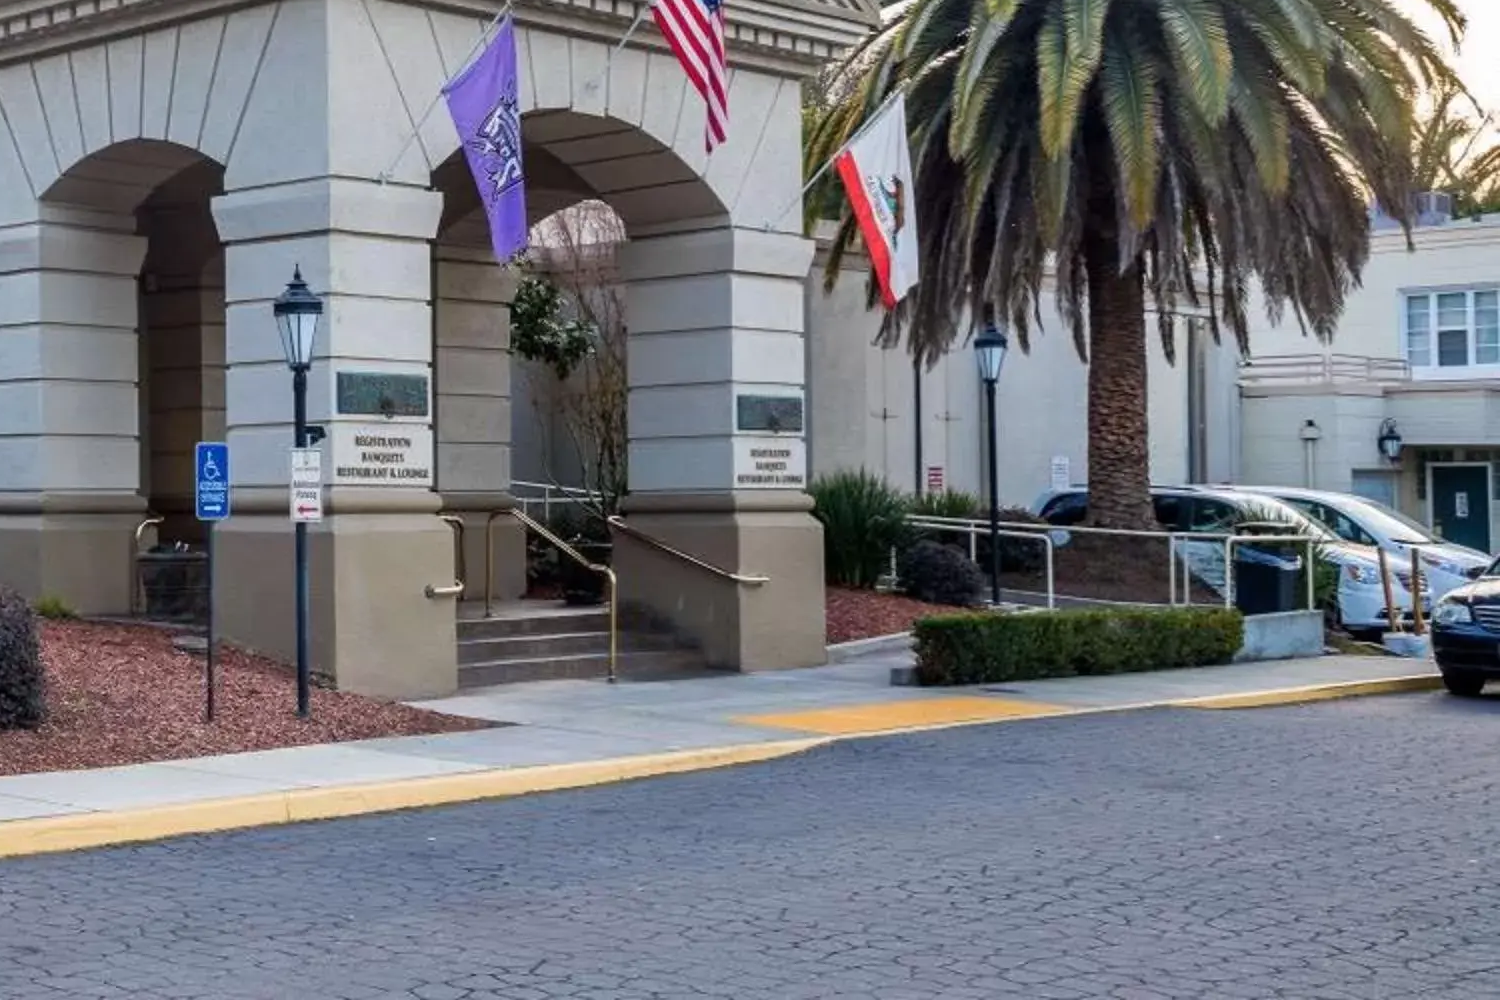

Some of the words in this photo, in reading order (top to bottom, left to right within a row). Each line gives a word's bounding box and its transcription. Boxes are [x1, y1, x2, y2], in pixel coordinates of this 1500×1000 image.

[355, 435, 411, 447] REGISTRATION
[361, 452, 404, 464] BANQUETS
[398, 468, 429, 479] LOUNGE
